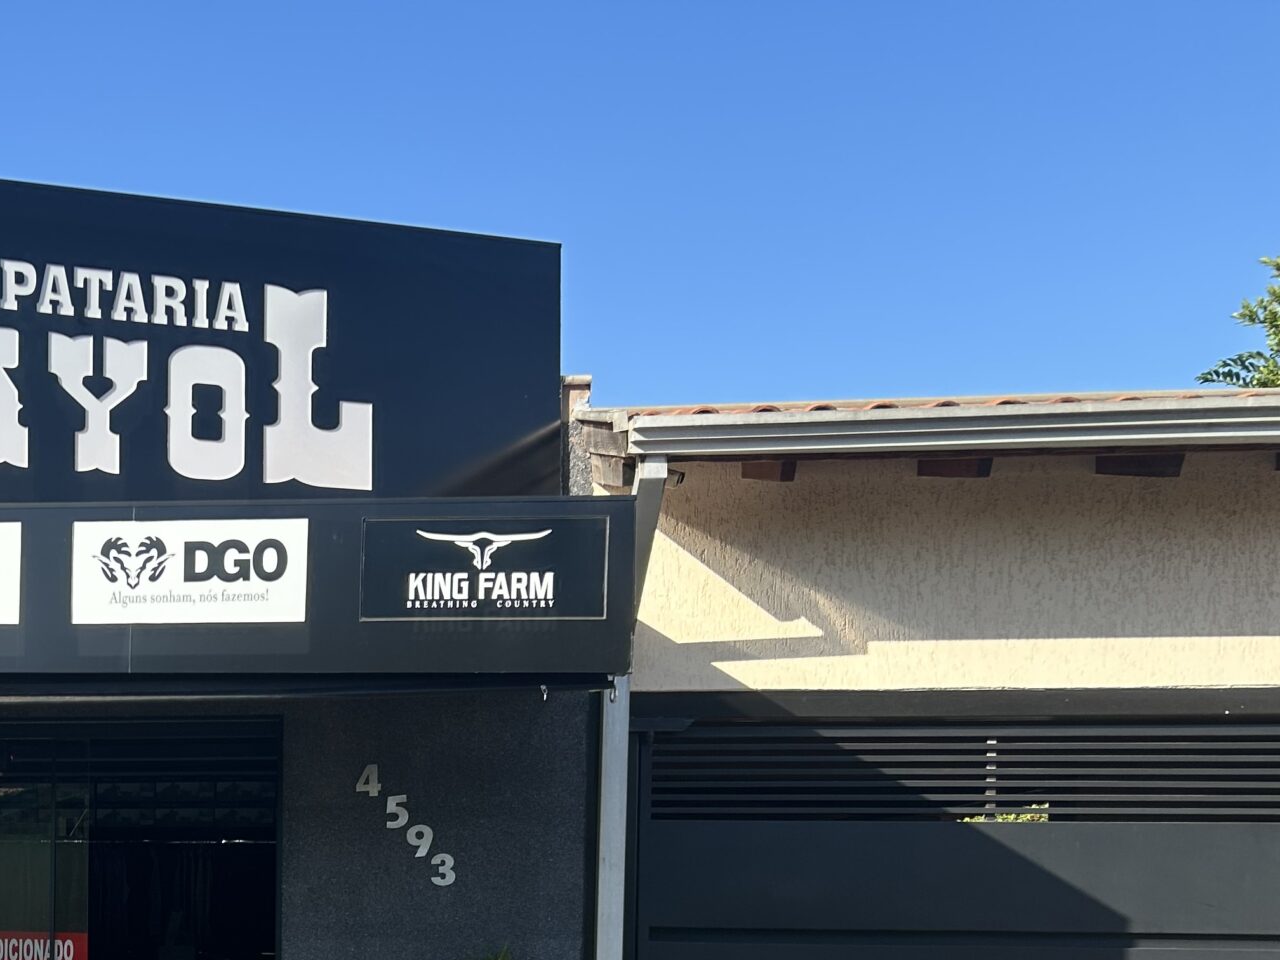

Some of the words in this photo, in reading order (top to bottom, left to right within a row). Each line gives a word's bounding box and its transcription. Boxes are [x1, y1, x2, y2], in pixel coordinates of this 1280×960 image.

[183, 538, 288, 583] DGO
[109, 590, 148, 608] Alguns
[150, 589, 196, 605] sonham,
[199, 588, 219, 603] nós
[221, 588, 270, 603] fazemos!
[408, 572, 470, 600] KING
[477, 571, 555, 600] FARM
[406, 600, 478, 609] BREATHING
[496, 599, 555, 608] COUNTRY
[355, 763, 456, 887] 4593
